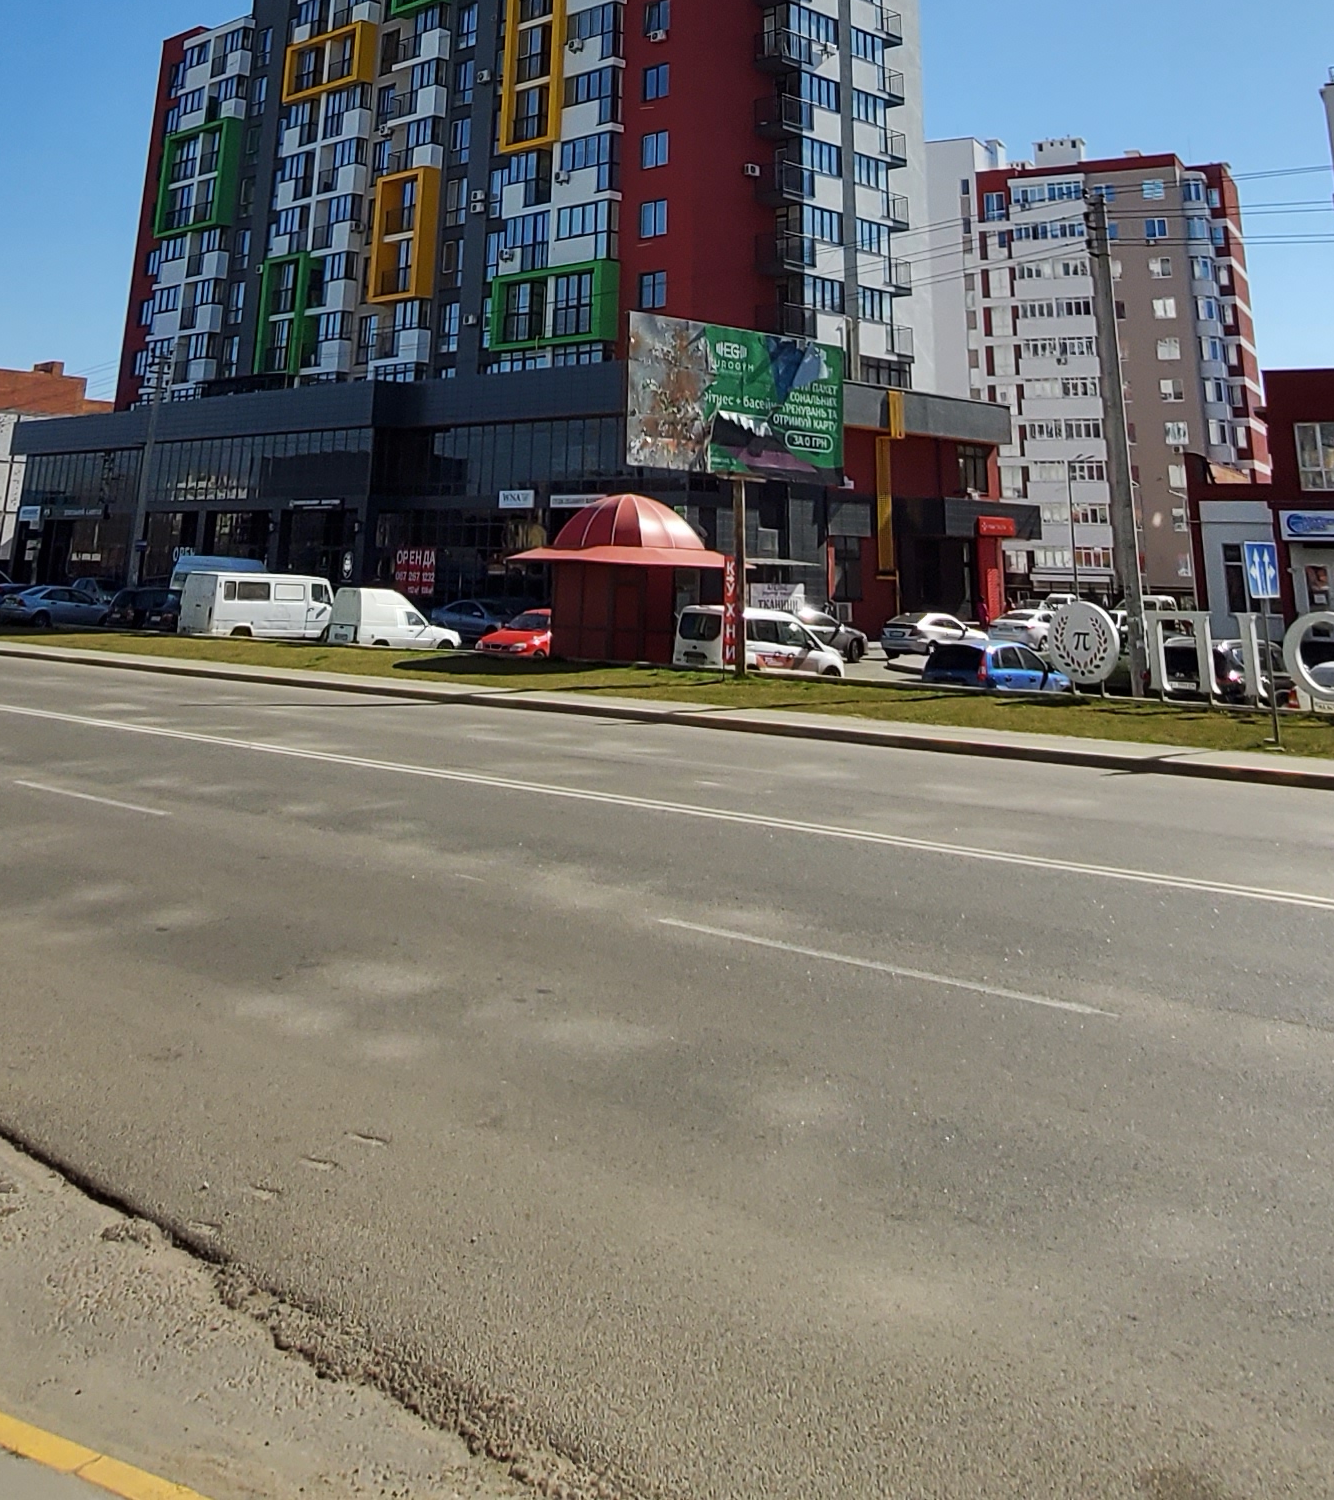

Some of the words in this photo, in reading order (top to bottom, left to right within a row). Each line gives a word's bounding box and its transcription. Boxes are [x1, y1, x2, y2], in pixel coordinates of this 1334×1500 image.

[714, 359, 754, 373] UROGYM
[789, 391, 837, 407] СОНАЛЬНИХ
[792, 435, 804, 446] ЗА
[812, 437, 828, 449] ГРН
[396, 549, 436, 569] ОРЕНДА
